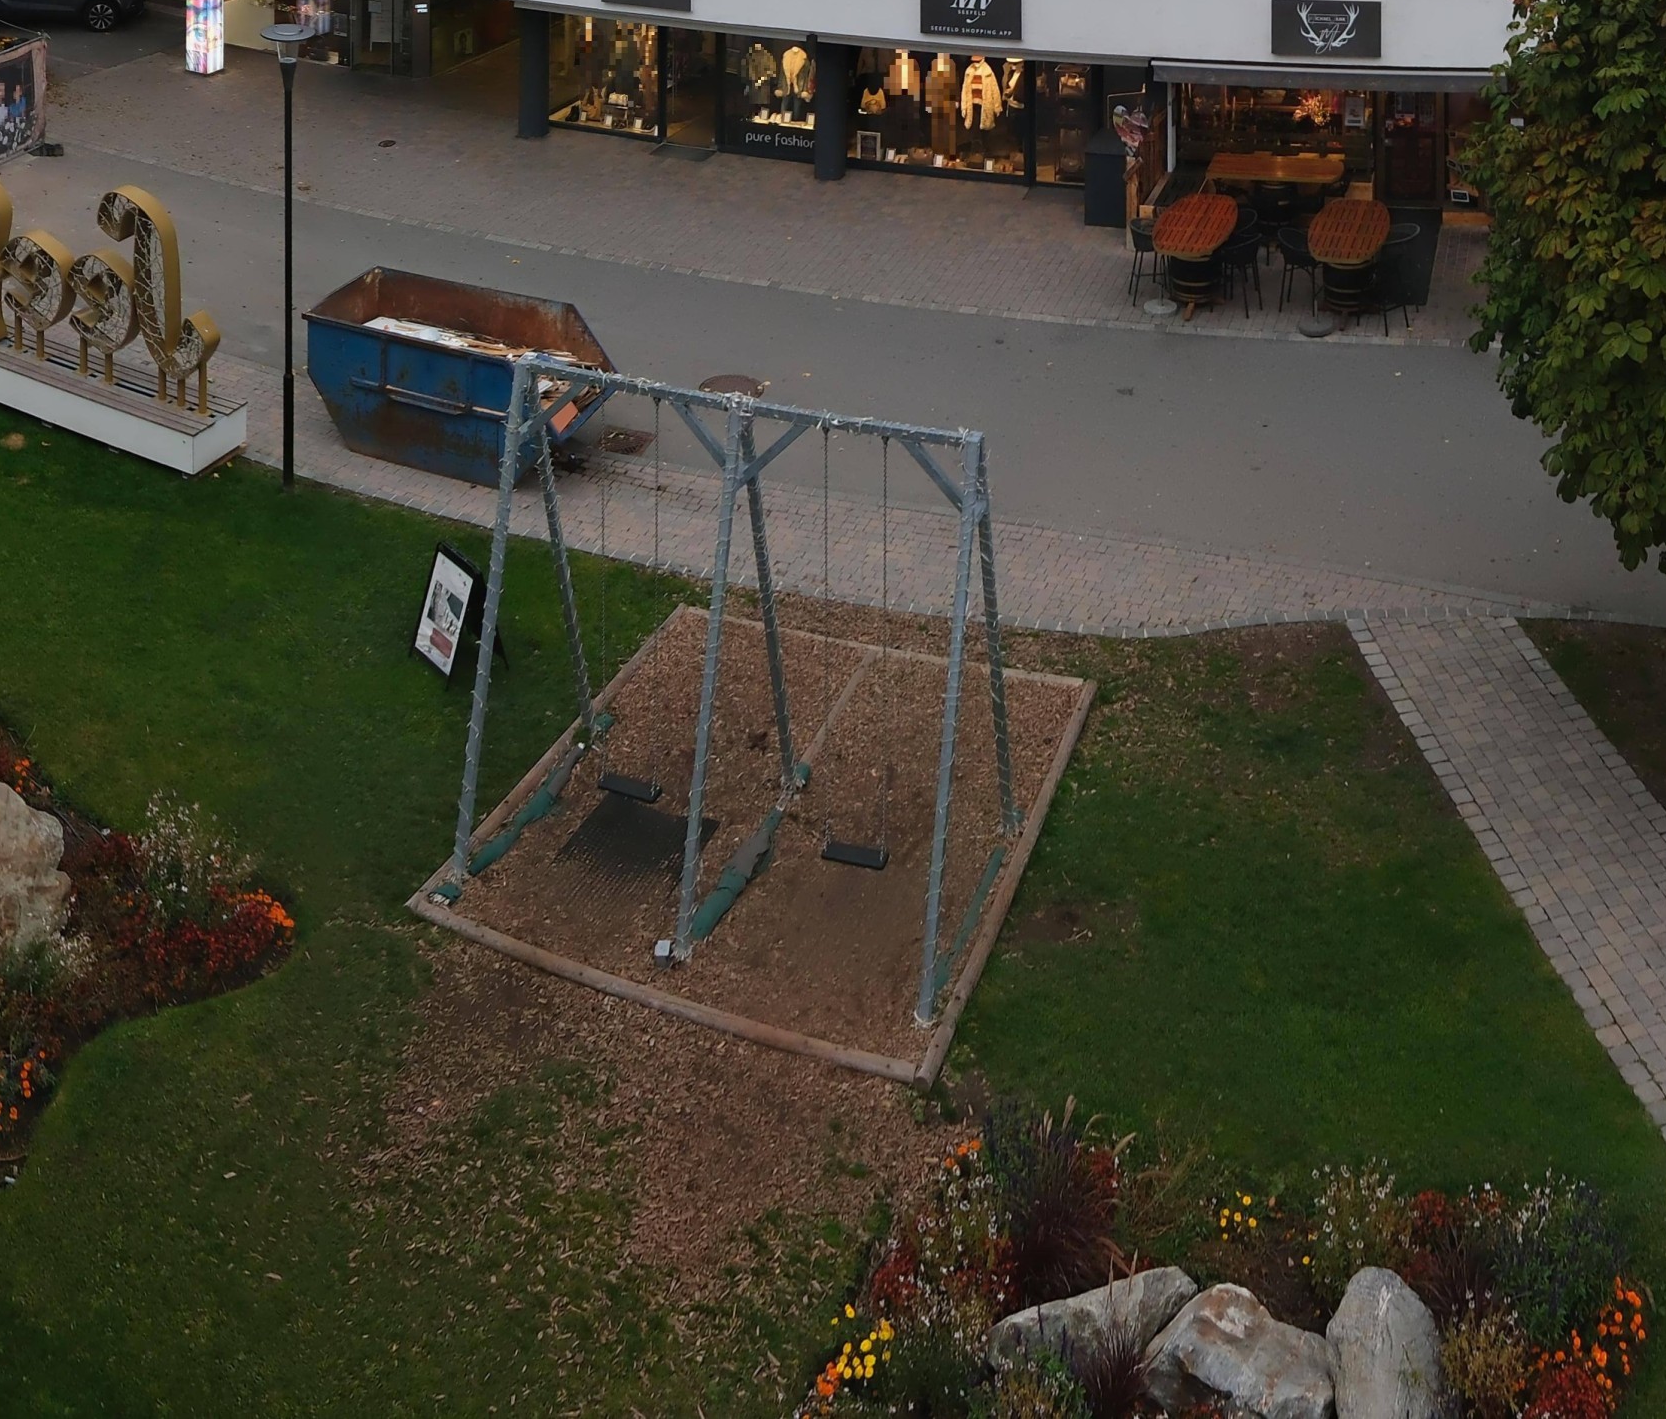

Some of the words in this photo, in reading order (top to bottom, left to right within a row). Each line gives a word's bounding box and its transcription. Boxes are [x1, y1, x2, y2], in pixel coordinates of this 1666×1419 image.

[931, 25, 959, 33] SEEFELD
[962, 27, 996, 35] SHOPPING
[746, 132, 772, 143] pure
